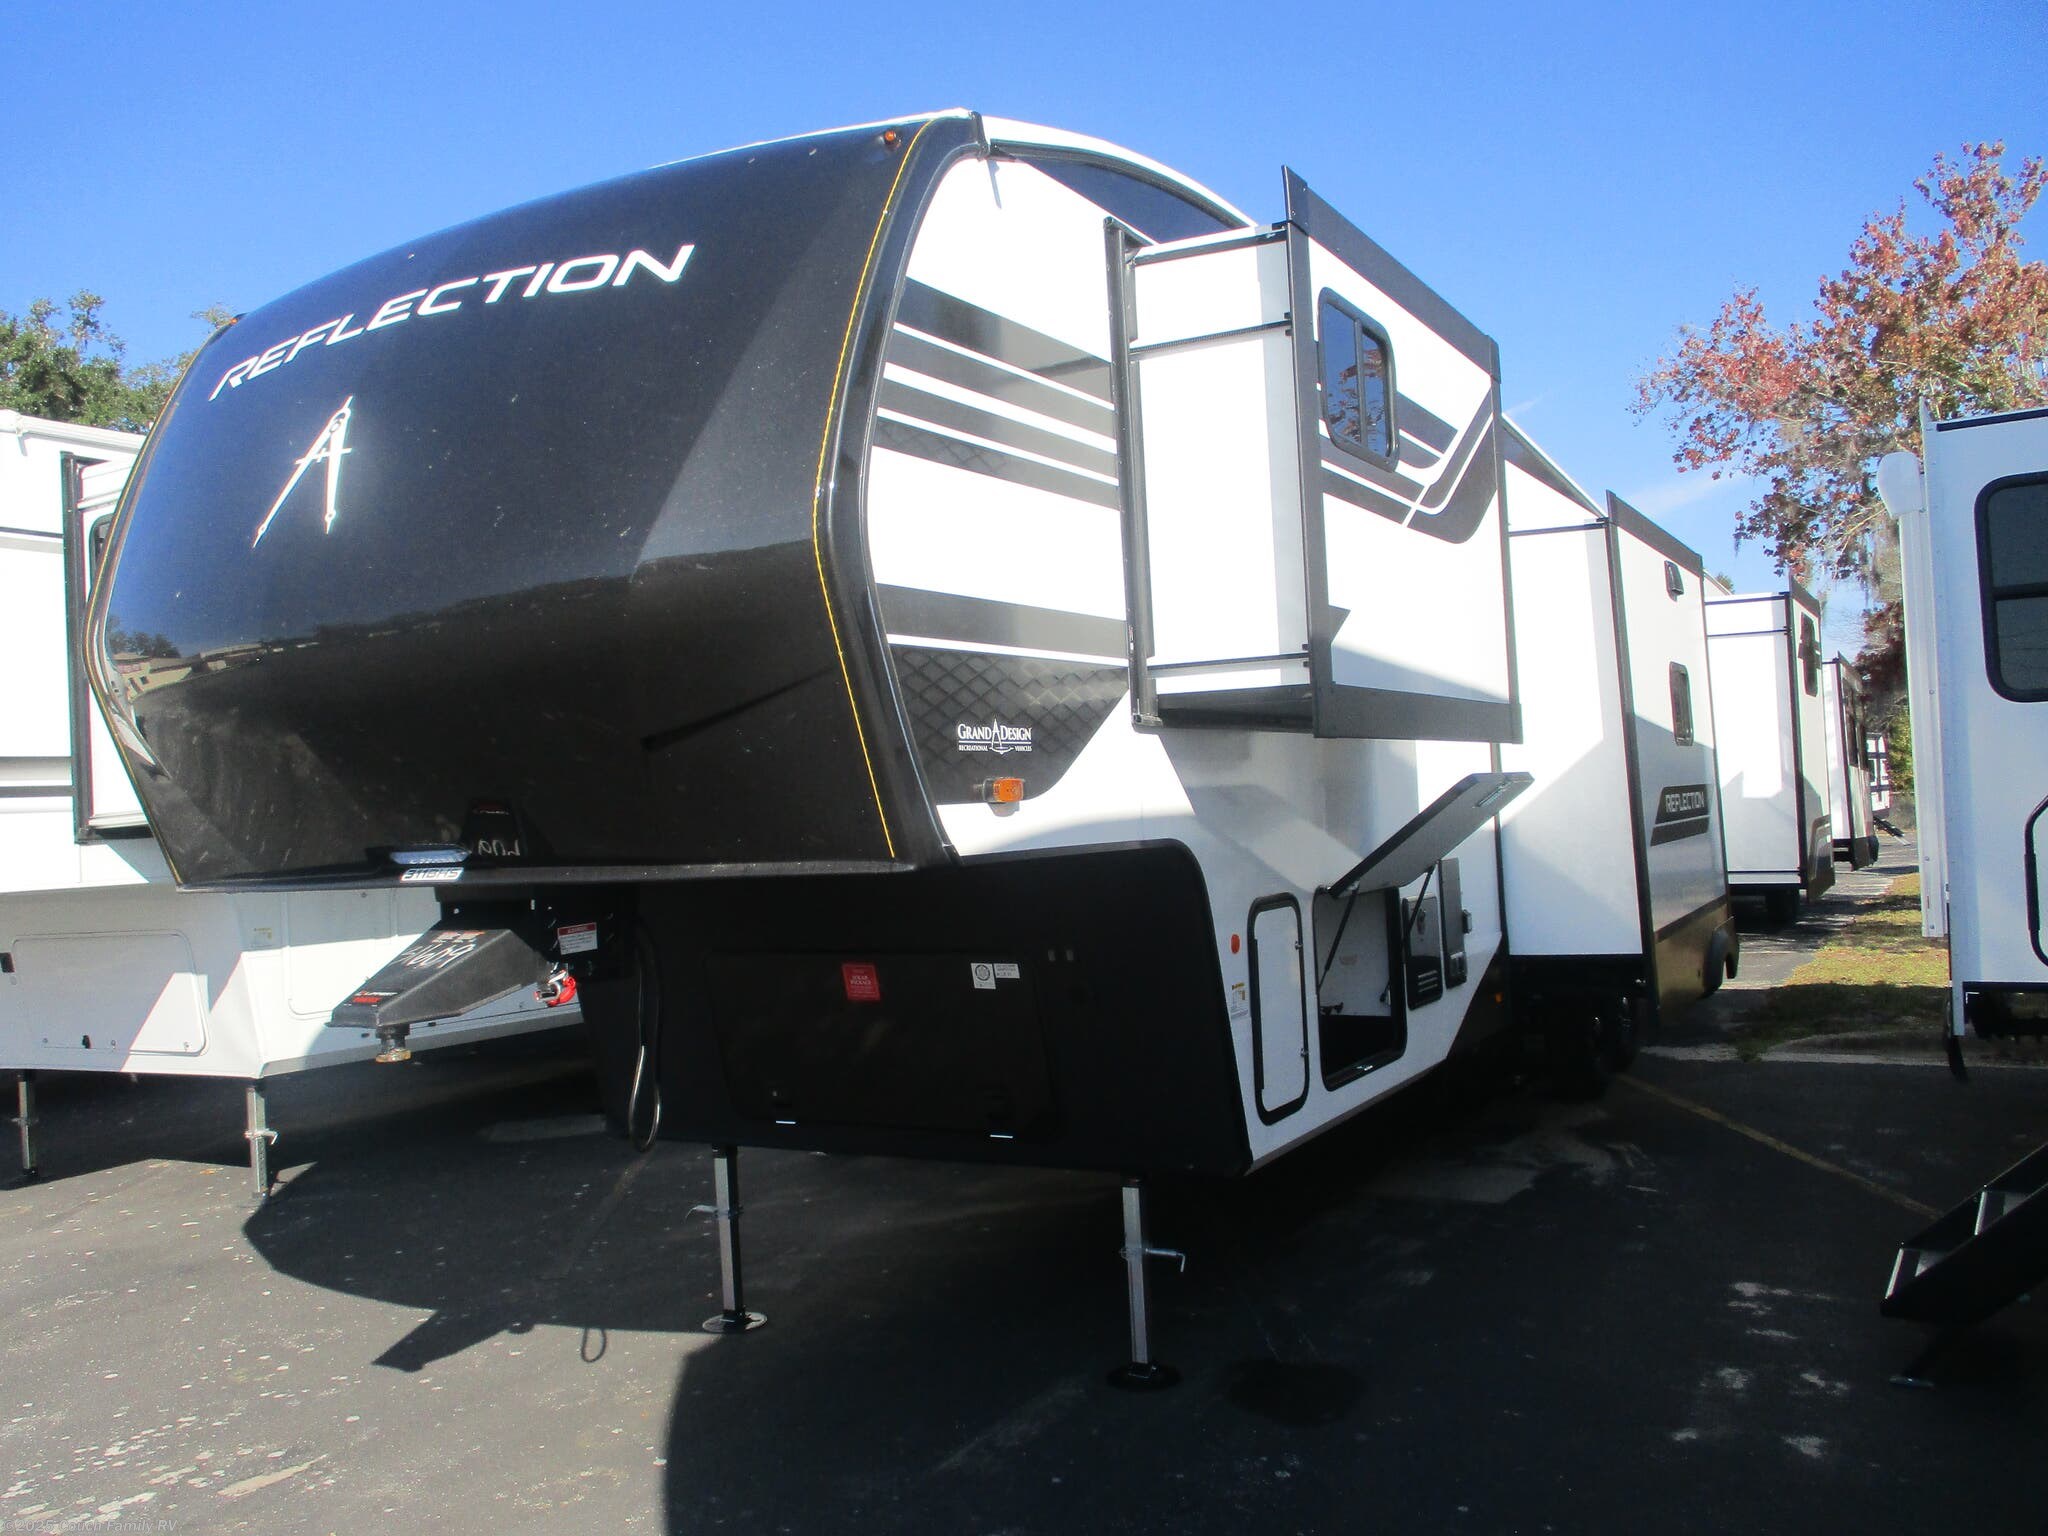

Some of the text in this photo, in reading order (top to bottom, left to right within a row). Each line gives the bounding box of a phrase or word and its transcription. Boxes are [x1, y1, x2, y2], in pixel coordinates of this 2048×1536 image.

[209, 244, 696, 402] REFLECTION
[957, 724, 1032, 740] GRAND DESIGN
[1665, 791, 1705, 813] REFLECTION
